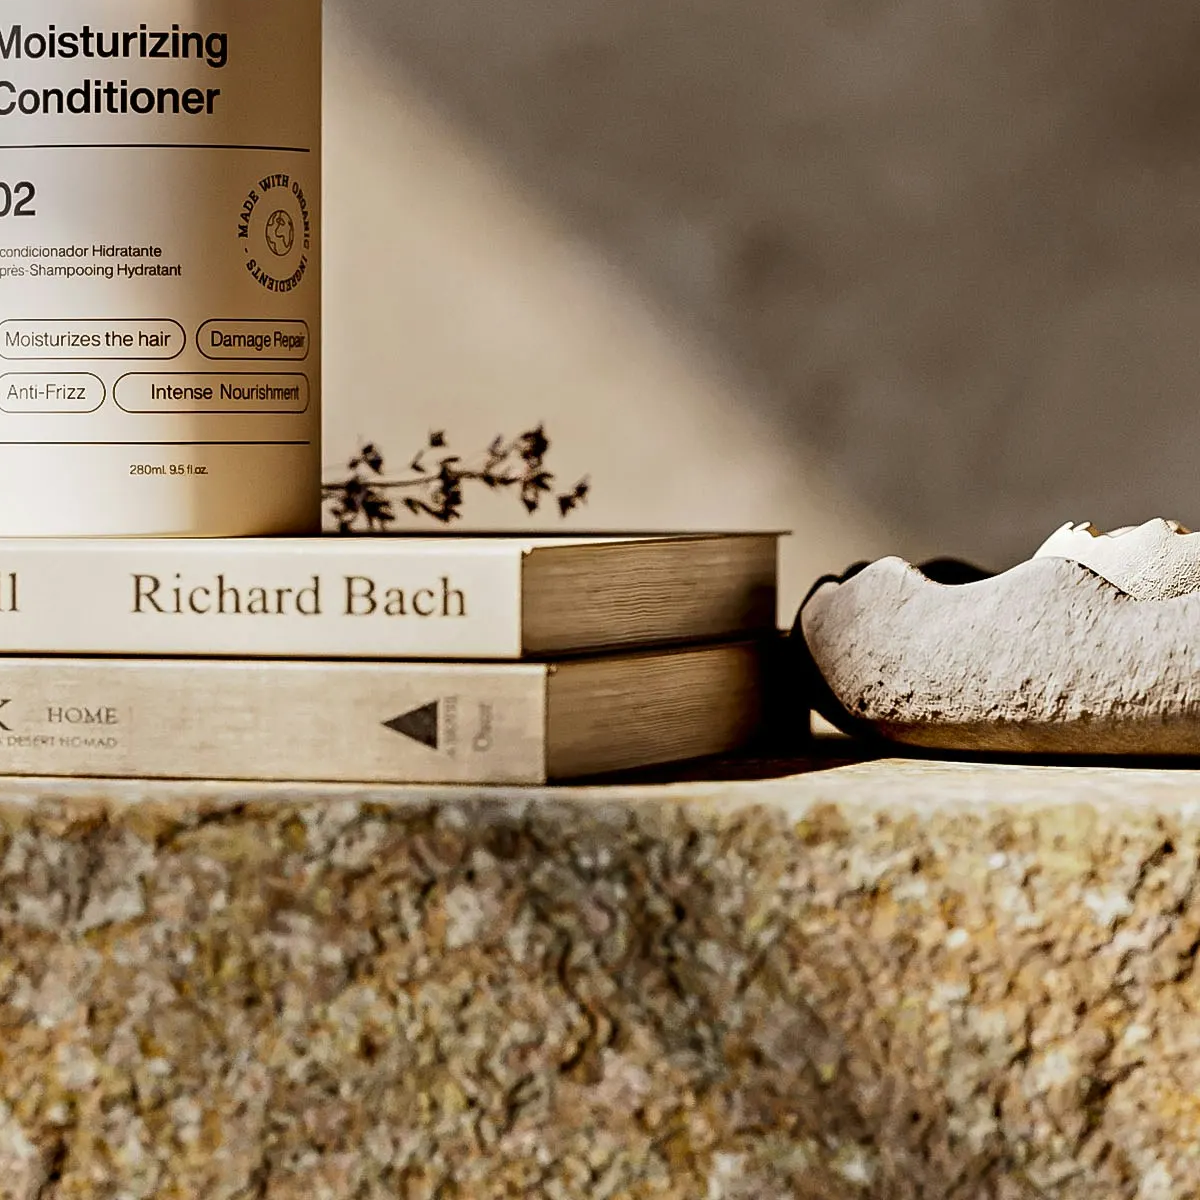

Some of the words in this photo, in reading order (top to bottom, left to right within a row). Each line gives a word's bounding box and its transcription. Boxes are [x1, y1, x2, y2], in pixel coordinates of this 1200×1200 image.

[258, 174, 289, 192] WITH
[238, 190, 260, 238] MADE
[292, 182, 310, 250] ORGANIC
[92, 245, 162, 258] Hidratante
[117, 264, 182, 279] Hydratant
[246, 254, 308, 292] INGREDIENTS
[5, 331, 101, 348] Moisturizes
[104, 331, 134, 348] the
[138, 331, 171, 348] hair
[211, 330, 271, 351] Damage
[273, 331, 305, 351] Repair
[7, 384, 86, 400] Anti-Frizz
[151, 384, 213, 400] Intense
[220, 383, 300, 400] Nourishment
[130, 572, 323, 616] Richard
[343, 575, 467, 617] Bach
[47, 706, 118, 725] HOME
